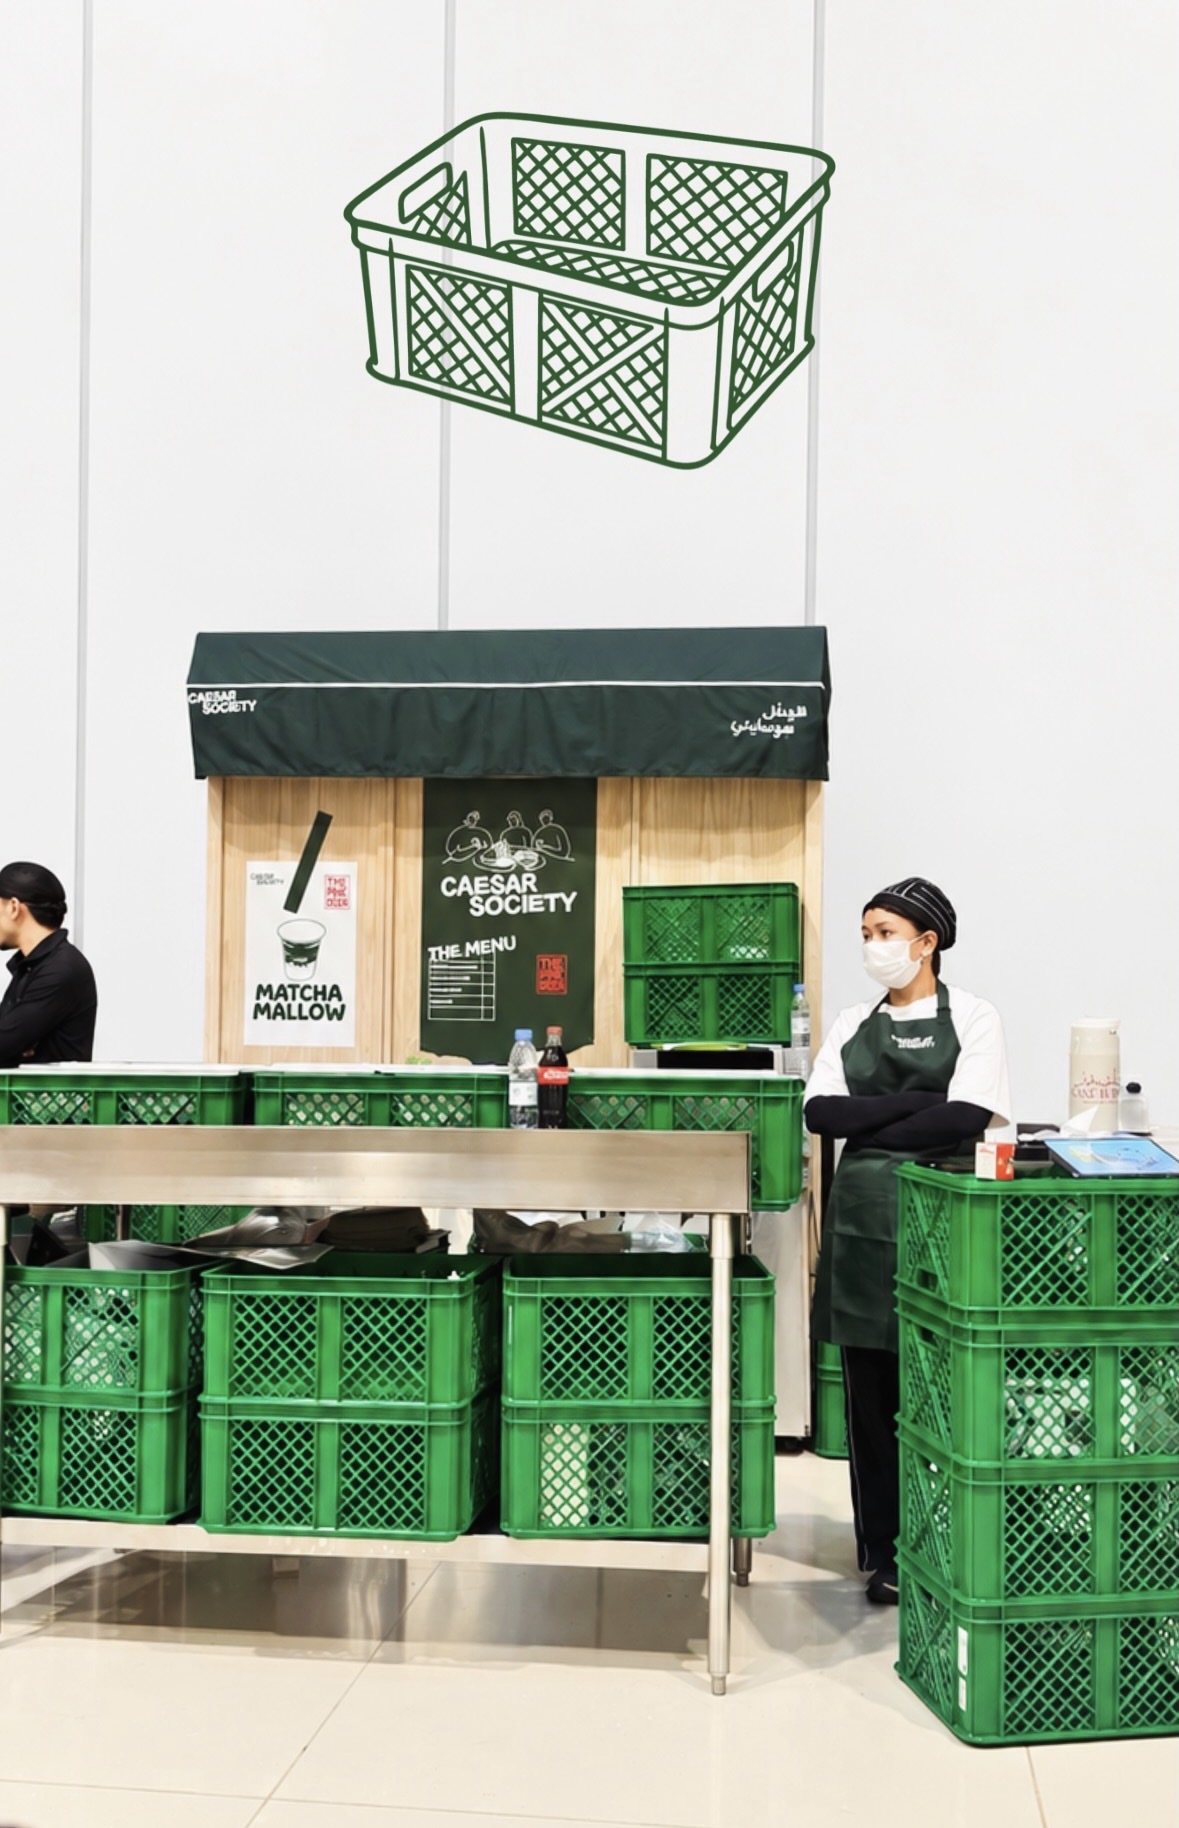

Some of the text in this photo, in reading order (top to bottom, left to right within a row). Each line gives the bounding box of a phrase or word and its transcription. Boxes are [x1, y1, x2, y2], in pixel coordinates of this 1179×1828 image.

[188, 690, 237, 704] CAESAR
[202, 700, 257, 715] SOCIETY
[440, 873, 538, 897] CAESAR
[469, 891, 578, 917] SOCIETY
[427, 935, 516, 962] THE MENU
[255, 984, 343, 1002] MATCHA
[252, 1002, 346, 1021] MALLOW
